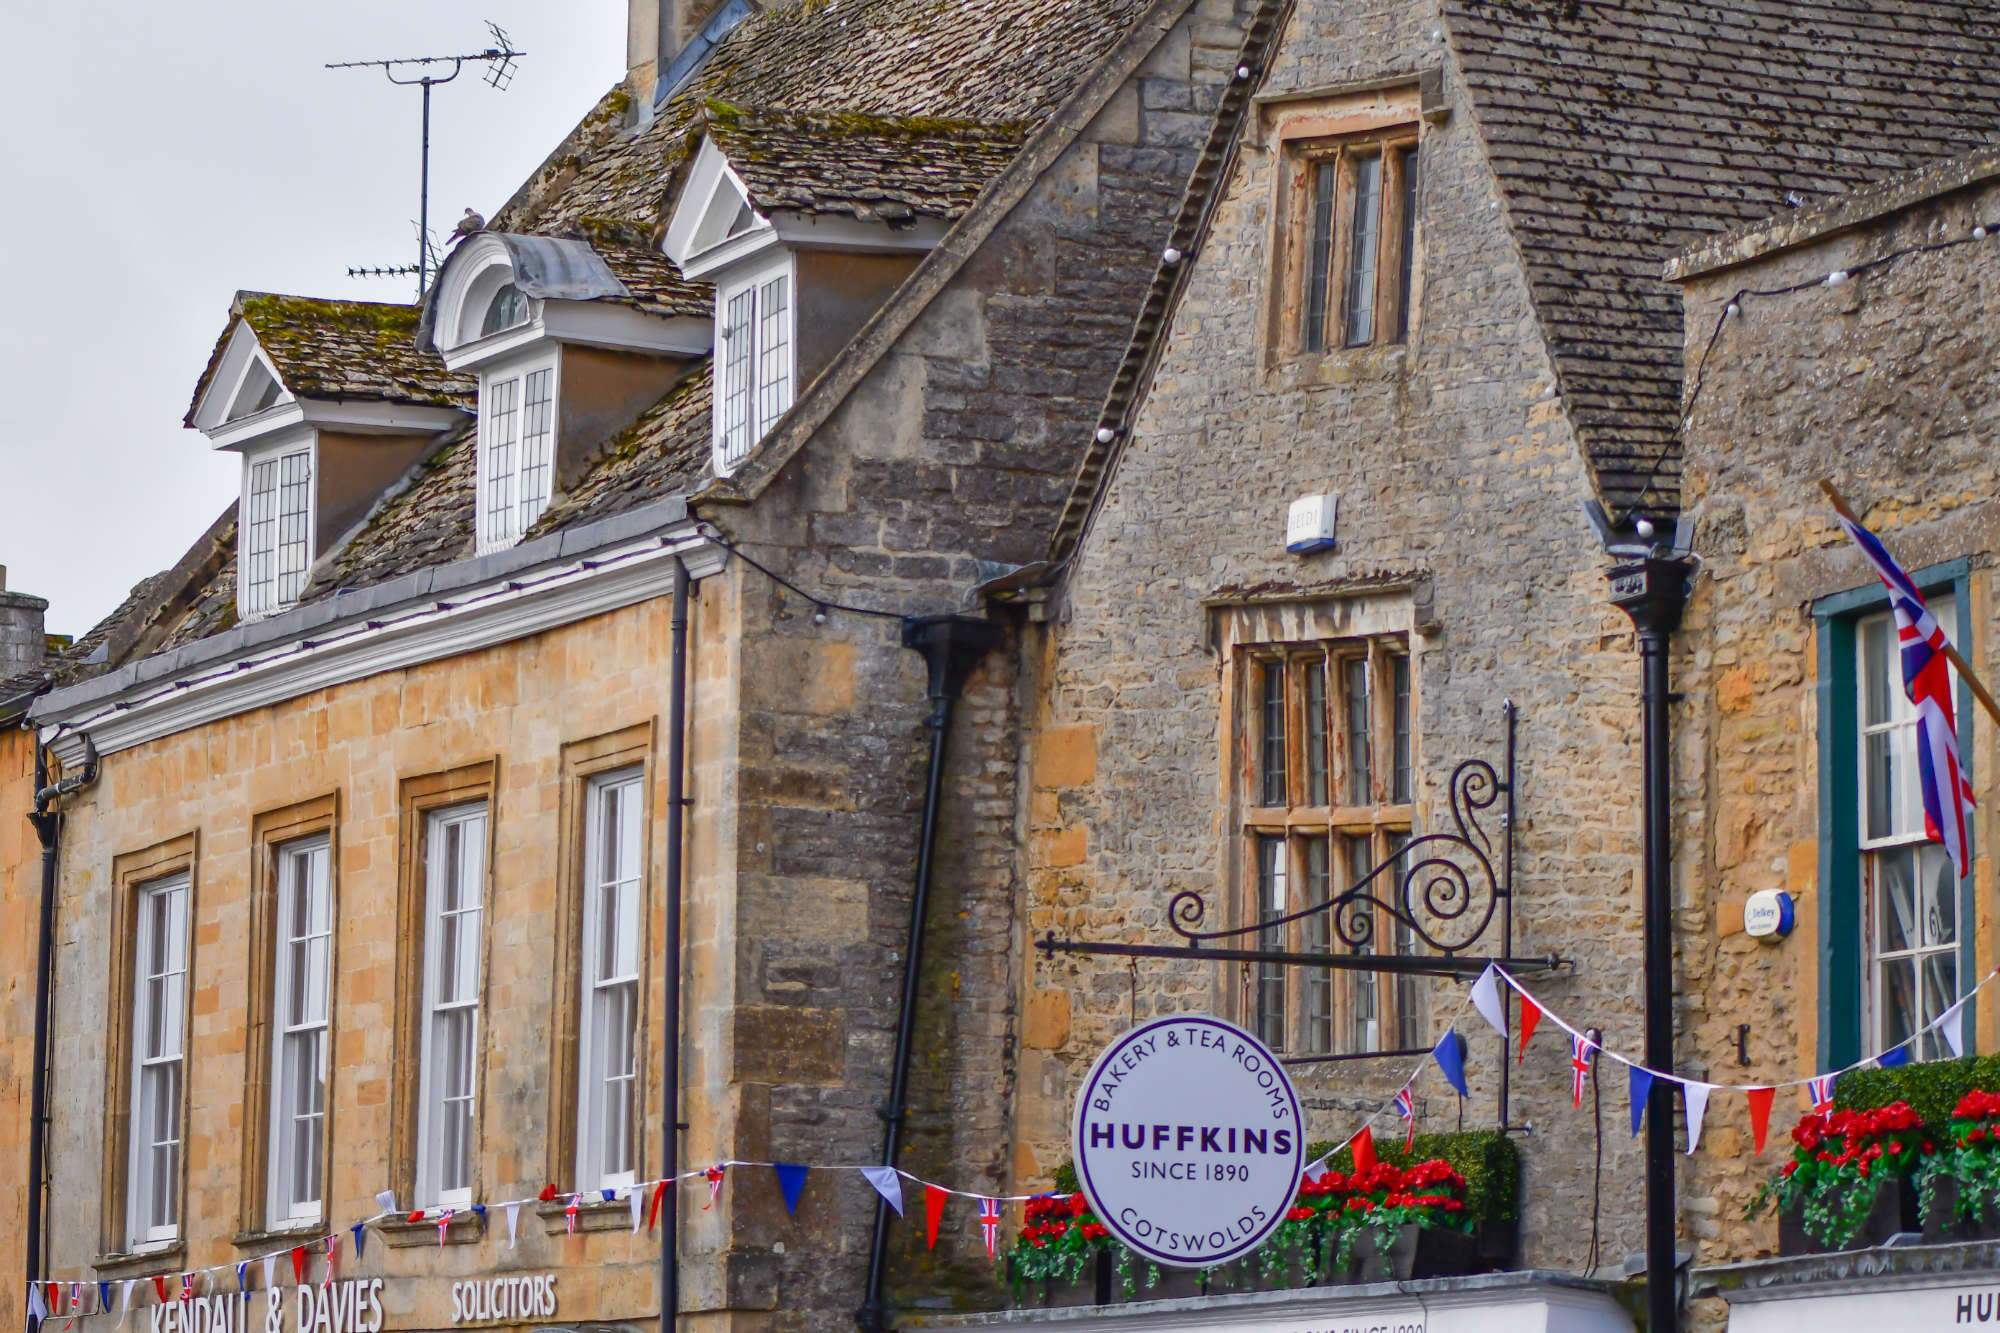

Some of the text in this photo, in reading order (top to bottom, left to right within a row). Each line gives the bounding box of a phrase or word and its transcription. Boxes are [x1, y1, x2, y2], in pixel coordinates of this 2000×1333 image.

[1094, 1028, 1289, 1119] BAKERY & TEA ROOMS
[1091, 1122, 1291, 1155] HUFFKINS
[1132, 1161, 1249, 1182] SINCE 1890
[1121, 1205, 1266, 1251] COTSWOLDS
[265, 1286, 283, 1333] &
[297, 1278, 383, 1333] DAVIES
[452, 1274, 556, 1321] SOLICITORS
[1956, 1292, 2000, 1323] HU
